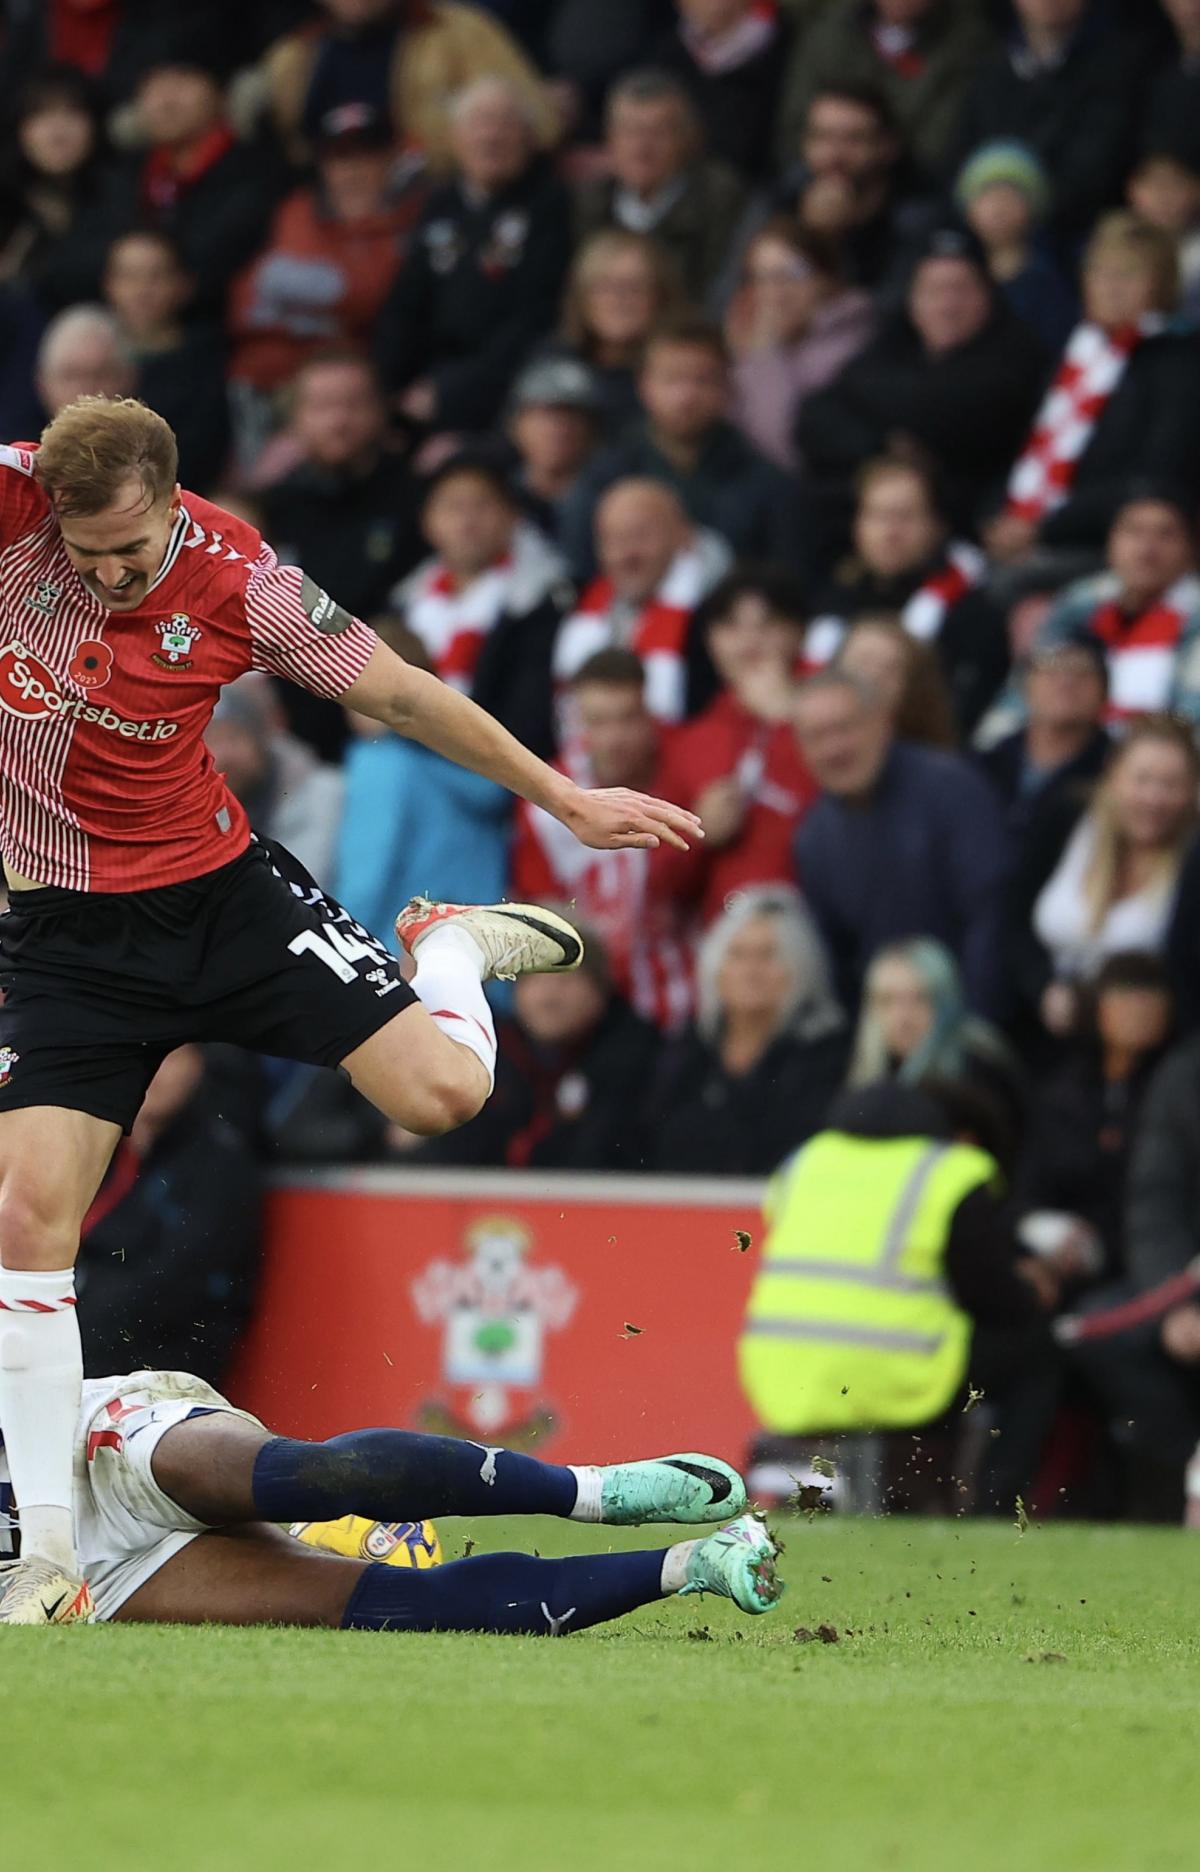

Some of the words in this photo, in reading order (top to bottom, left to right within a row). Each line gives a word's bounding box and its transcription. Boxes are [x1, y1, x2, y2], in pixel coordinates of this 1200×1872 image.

[7, 661, 179, 740] Sportsbet.io
[73, 671, 98, 685] 2023
[286, 922, 388, 984] 14
